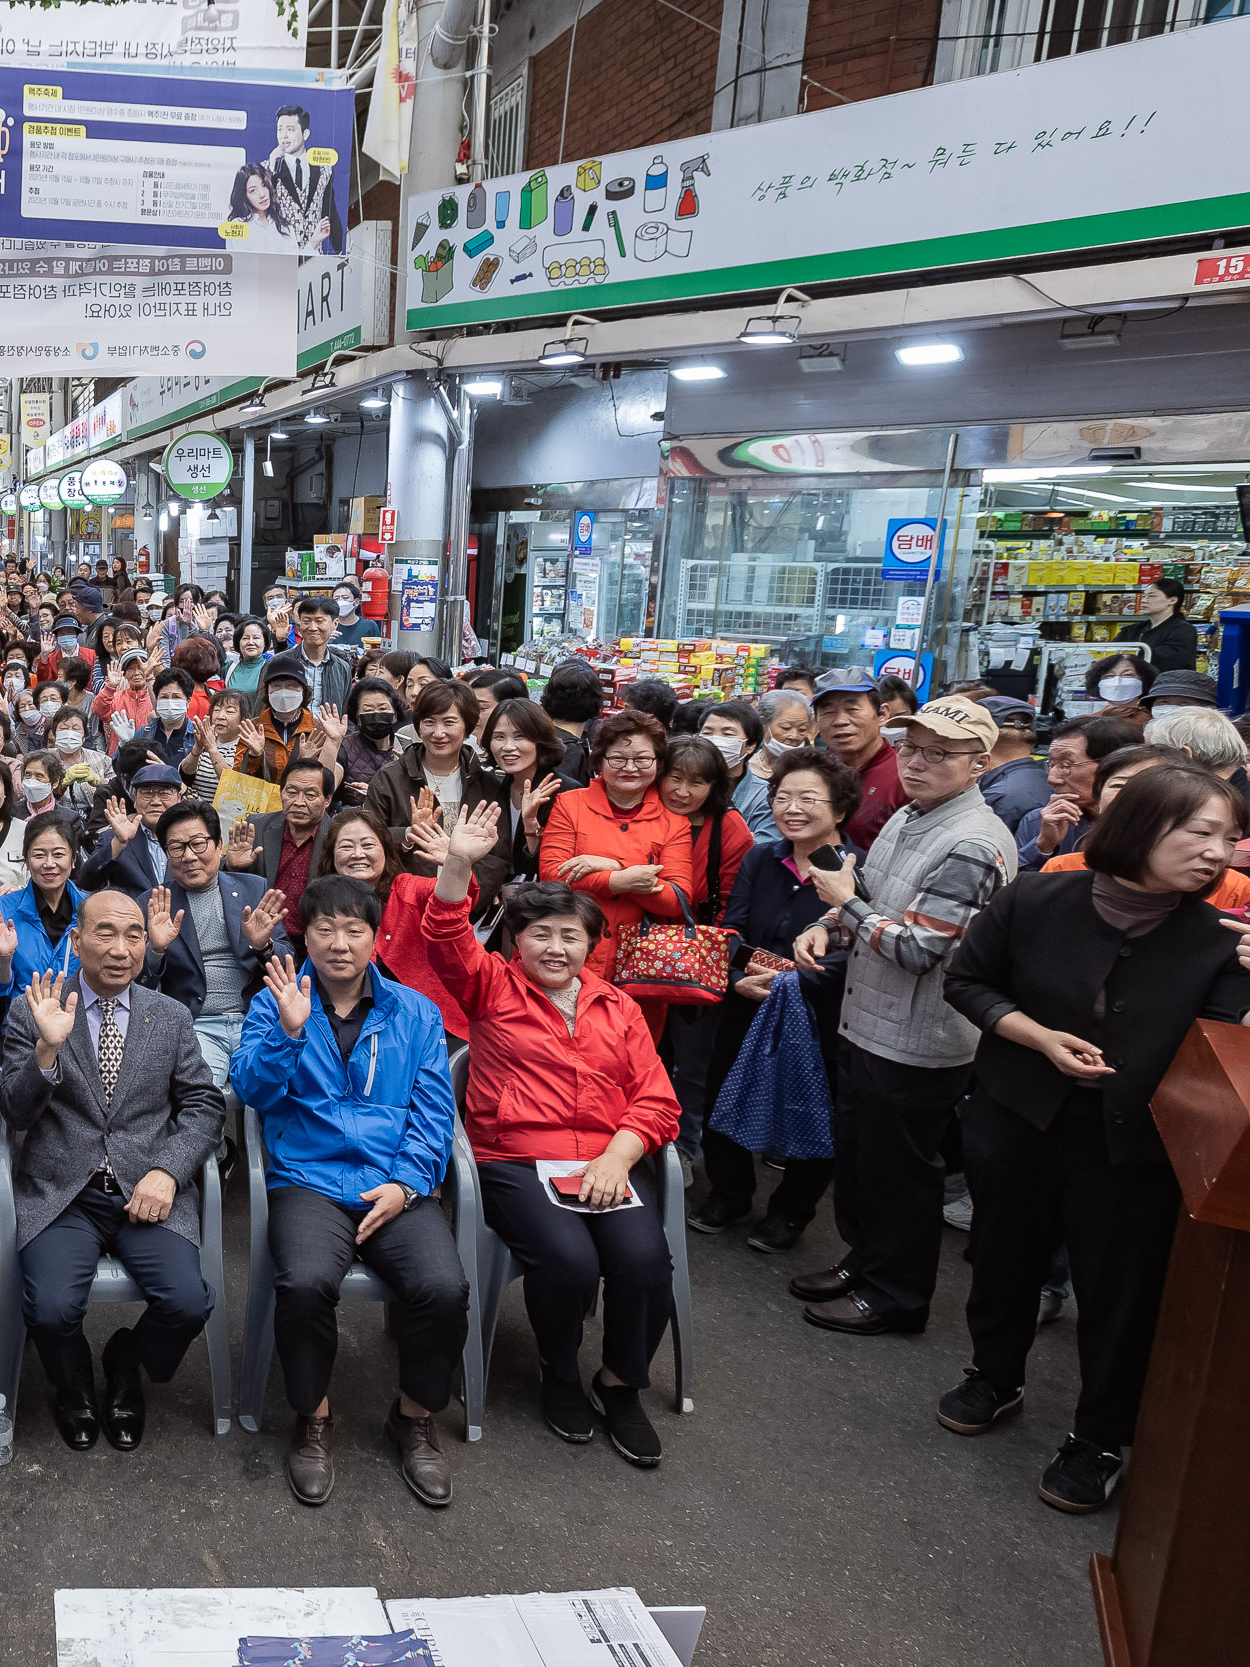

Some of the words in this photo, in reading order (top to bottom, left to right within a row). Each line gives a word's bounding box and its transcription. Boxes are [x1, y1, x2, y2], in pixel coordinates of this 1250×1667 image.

[28, 87, 57, 98] 맥주축제
[170, 110, 182, 120] 무료
[184, 111, 197, 121] 증정
[28, 125, 57, 136] 경품추첨
[59, 126, 81, 137] 이벤트
[42, 165, 54, 173] 기간
[750, 174, 818, 203] 상품의
[927, 142, 977, 175] 뭐든
[993, 140, 1018, 157] 다
[28, 187, 40, 195] 추첨
[297, 258, 350, 334] ART
[174, 447, 223, 462] 우리마트
[186, 463, 211, 479] 생선
[191, 485, 207, 494] 생선
[897, 534, 934, 550] 담배
